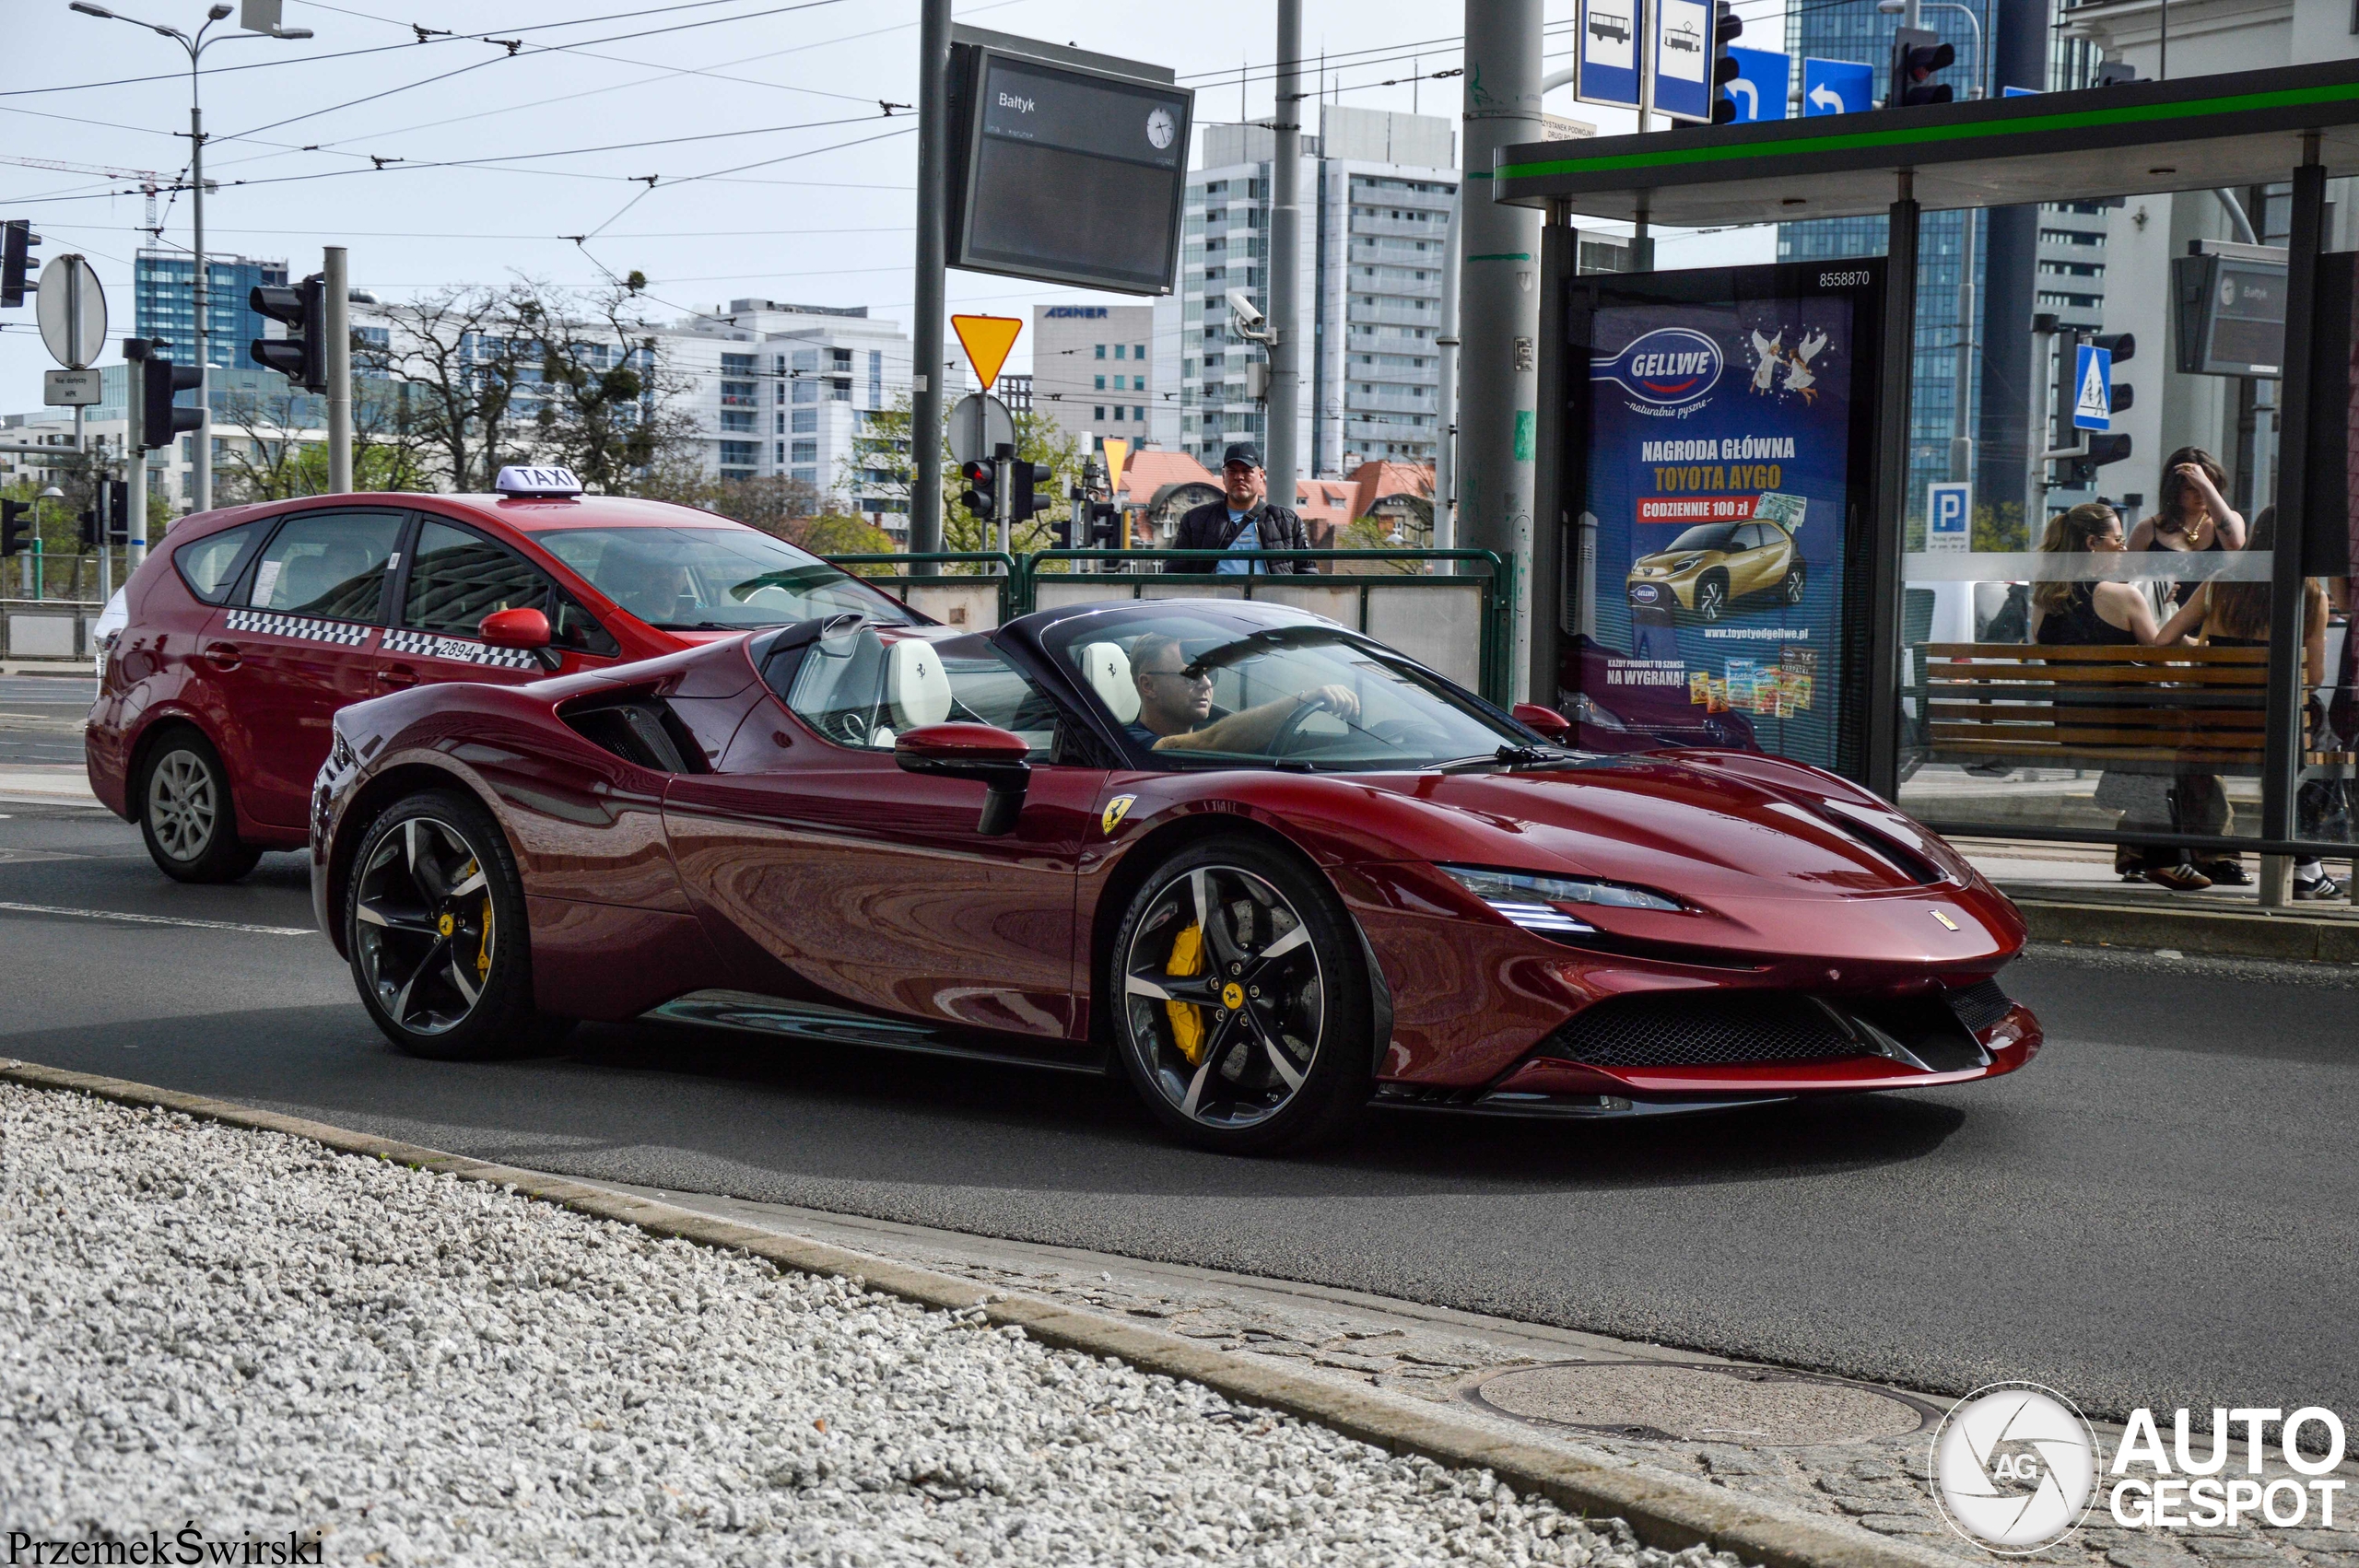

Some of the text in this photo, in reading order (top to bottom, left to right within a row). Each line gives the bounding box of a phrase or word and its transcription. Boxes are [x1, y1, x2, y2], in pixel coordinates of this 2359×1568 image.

[999, 92, 1035, 113] Bałtyk
[1542, 120, 1567, 132] ZYSTANEK
[1568, 125, 1595, 137] PODWÓJNY
[1819, 271, 1870, 287] 8558870
[1631, 351, 1710, 377] GELLWE
[1641, 435, 1795, 462] NAGRODA GŁÓWNA
[514, 469, 574, 486] TAXI
[1654, 464, 1782, 491] TOYOTA AYGO
[1642, 500, 1749, 518] CODZIENNIE 100 zł
[1940, 494, 1960, 528] P
[439, 641, 475, 659] 2894
[1608, 659, 1626, 668] KAŻDY
[1626, 660, 1654, 668] PRODUKT
[1662, 661, 1684, 669] SZANSA
[1607, 670, 1684, 688] NA WYGRANĄ!
